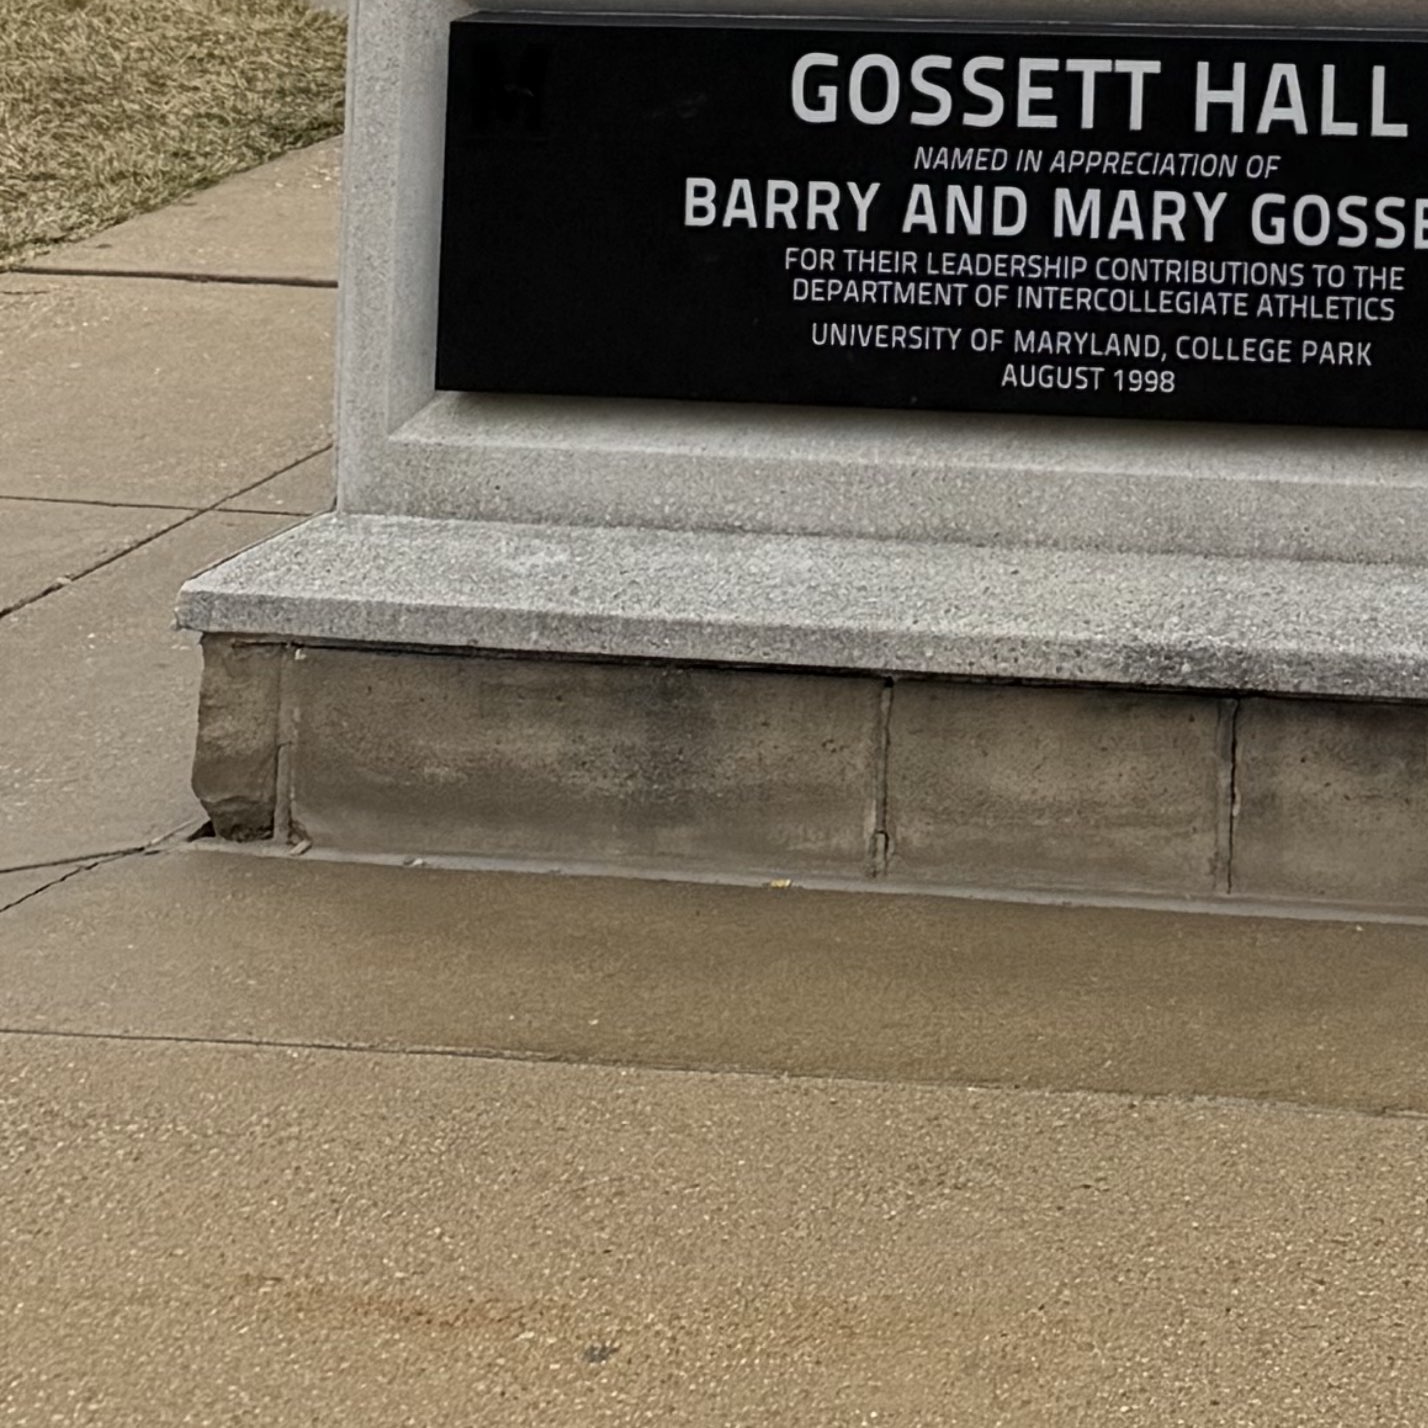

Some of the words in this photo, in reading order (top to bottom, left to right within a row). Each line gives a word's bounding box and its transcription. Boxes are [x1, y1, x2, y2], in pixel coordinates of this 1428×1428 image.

[792, 52, 1162, 131] GOSSETT
[1196, 61, 1408, 138] HALL
[914, 146, 1008, 171] NAMED
[1016, 149, 1043, 173] IN
[1050, 150, 1238, 178] APPRECIATION
[1246, 154, 1281, 179] OF
[685, 177, 881, 232] BARRY
[902, 183, 1028, 236] AND
[1054, 187, 1228, 243] MARY
[785, 247, 835, 271] FOR
[843, 249, 918, 274] THEIR
[927, 252, 1088, 279] LEADERSHIP
[1095, 257, 1304, 287] CONTRIBUTIONS
[1312, 264, 1345, 288] TO
[1353, 265, 1405, 291] THE
[793, 278, 968, 306] DEPARTMENT
[974, 284, 1009, 309] OF
[1017, 286, 1249, 317] INTERCOLLEGIATE
[1256, 293, 1396, 322] ATHLETICS
[811, 323, 962, 351] UNIVERSITY
[970, 328, 1004, 352] OF
[1014, 330, 1167, 362] MARYLAND,
[1176, 335, 1292, 363] COLLEGE
[1302, 340, 1372, 366] PARK
[1001, 363, 1105, 390] AUGUST
[1113, 369, 1175, 393] 1998
